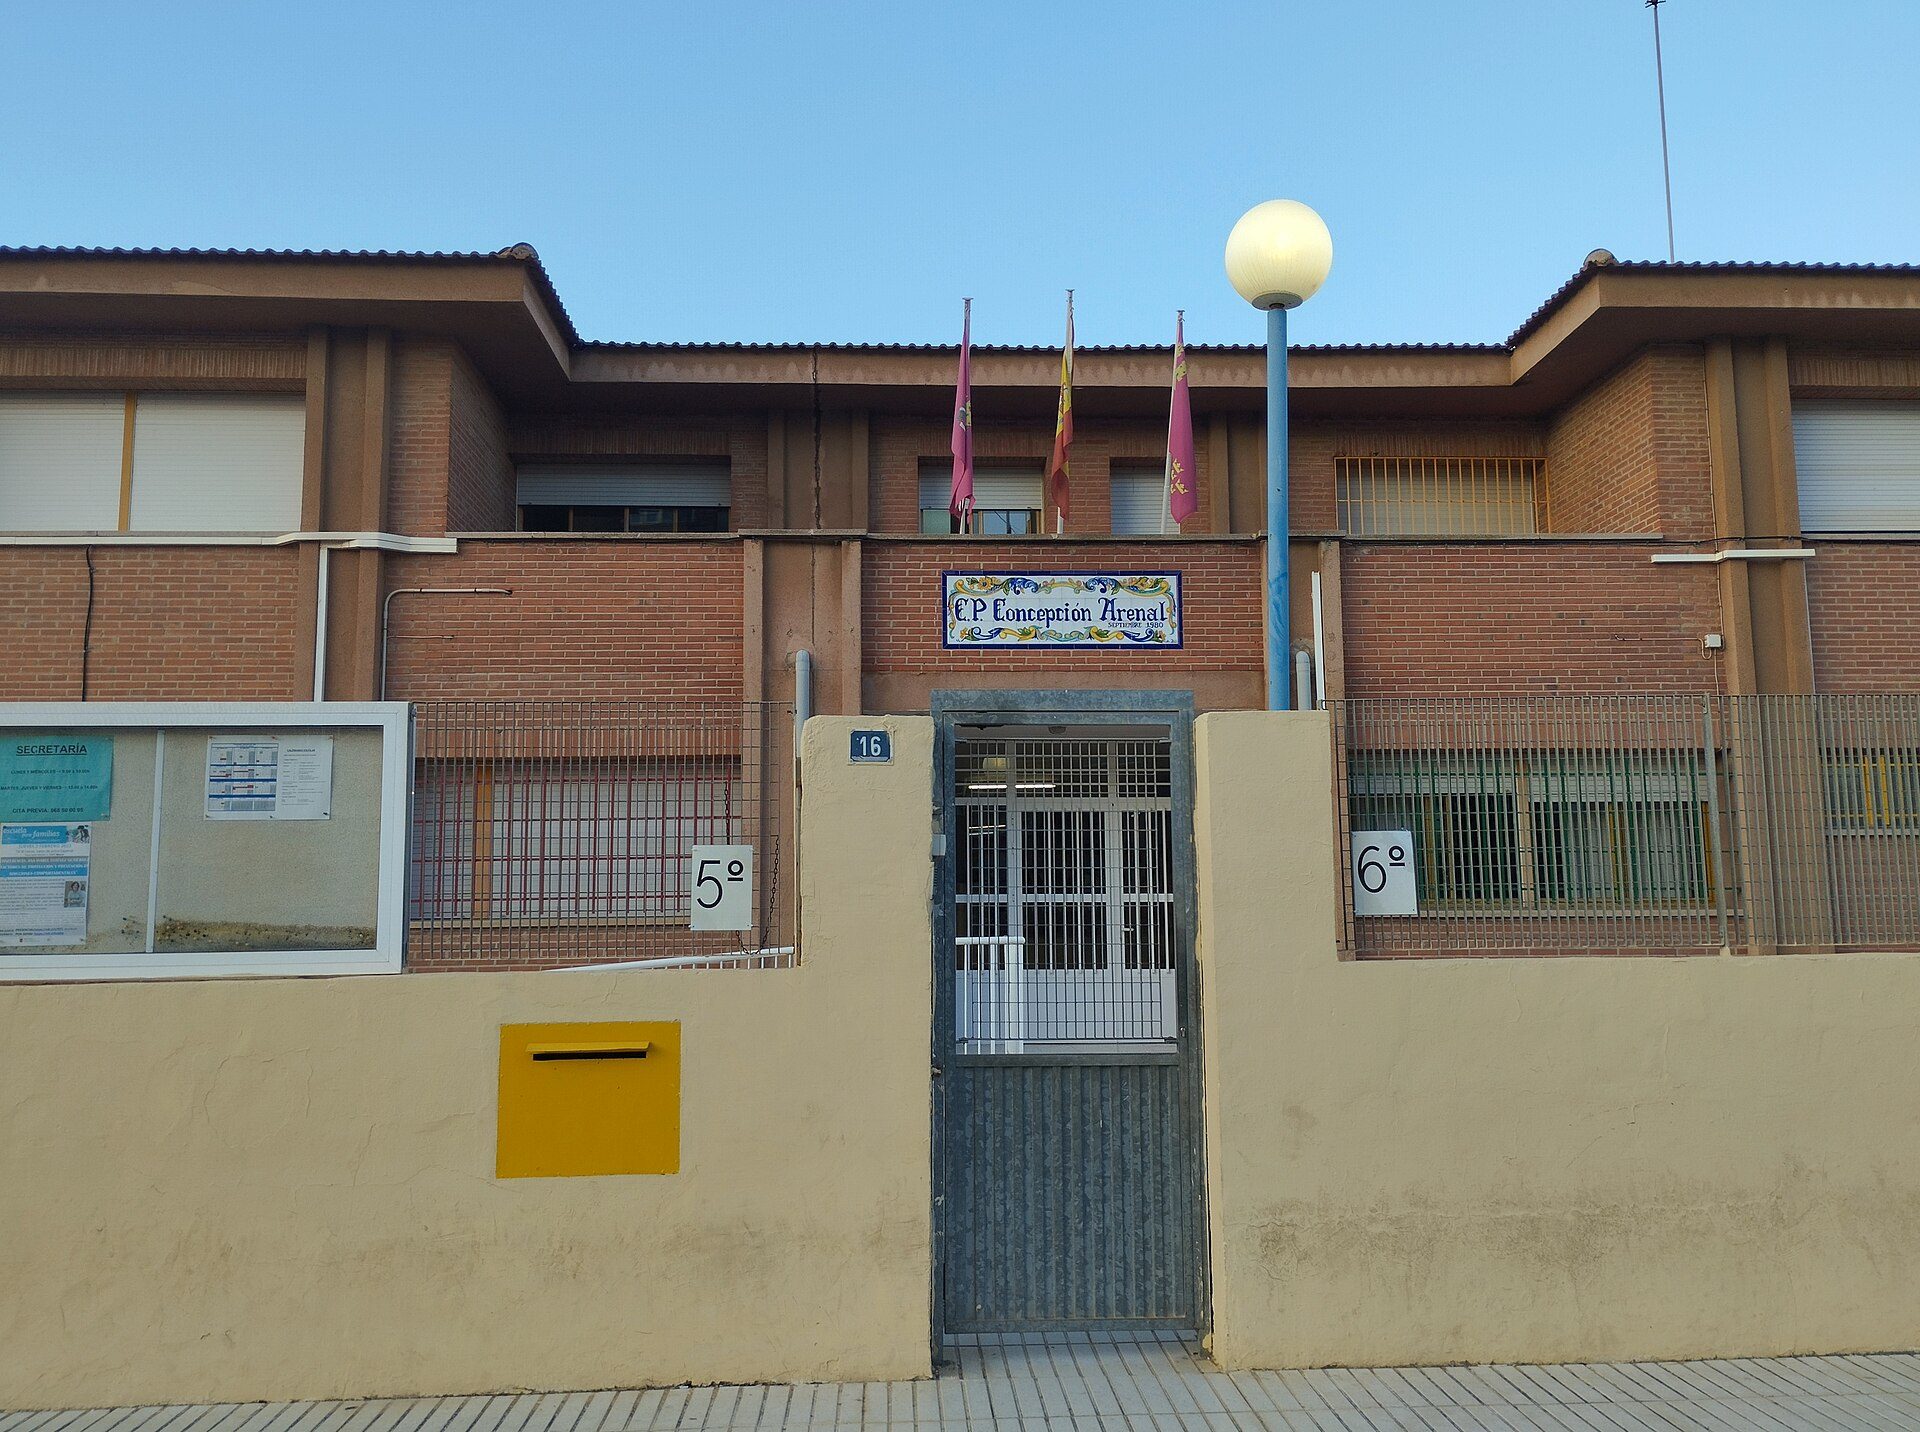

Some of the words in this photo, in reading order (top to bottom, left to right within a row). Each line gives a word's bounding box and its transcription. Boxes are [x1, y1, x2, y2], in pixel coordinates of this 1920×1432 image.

[993, 598, 1092, 628] Concepción
[1098, 597, 1168, 621] Arenal
[16, 743, 87, 754] SECRETARÍA
[859, 736, 881, 757] 16
[697, 860, 744, 909] 5º
[1358, 845, 1405, 893] 6º
